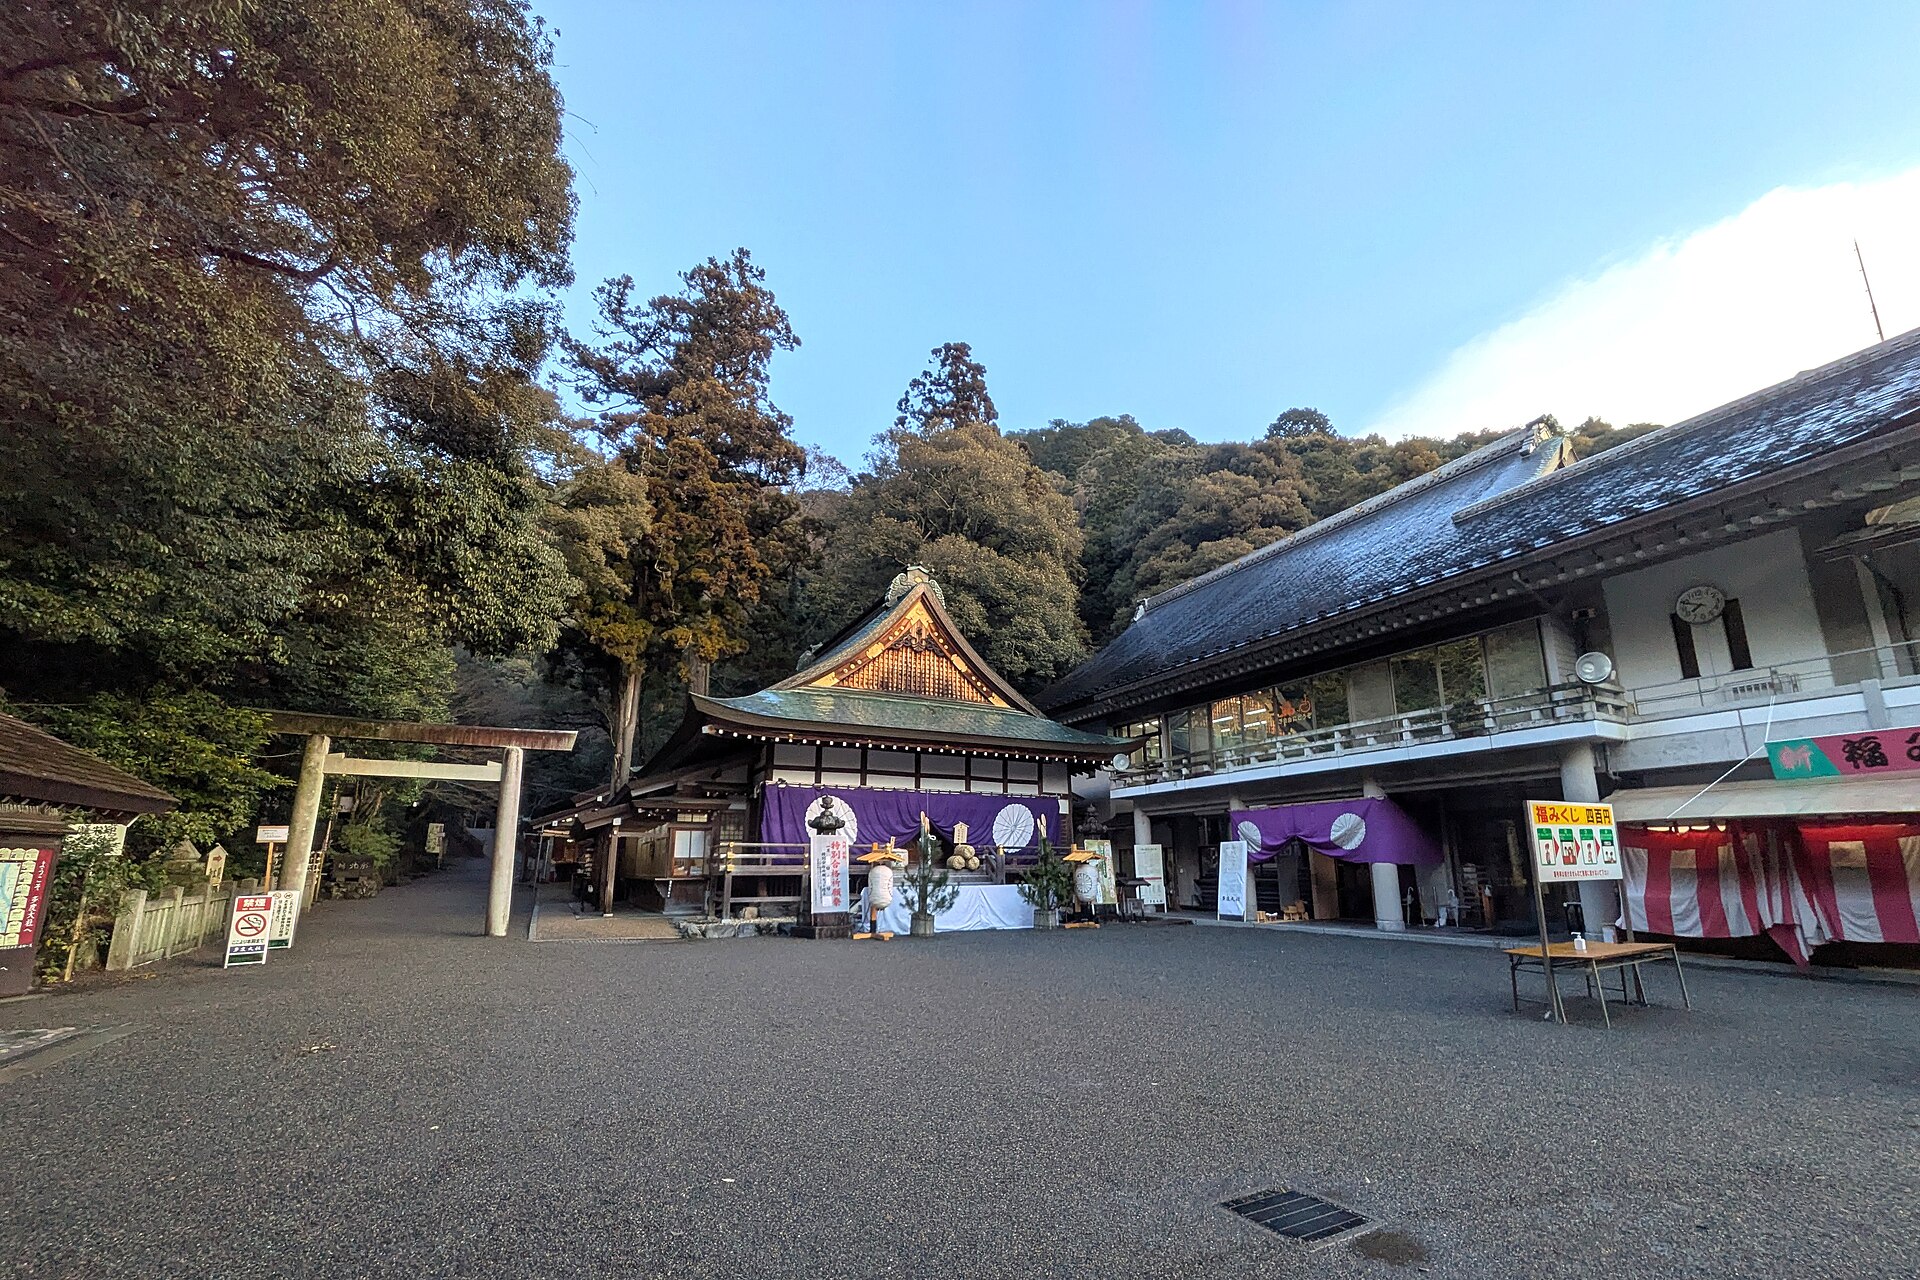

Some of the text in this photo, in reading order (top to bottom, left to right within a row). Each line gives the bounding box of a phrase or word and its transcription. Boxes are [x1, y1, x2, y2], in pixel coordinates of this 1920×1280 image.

[1536, 805, 1611, 824] 福みくじ 四百円
[34, 860, 46, 891] ようこそ
[243, 898, 266, 908] 禁煙
